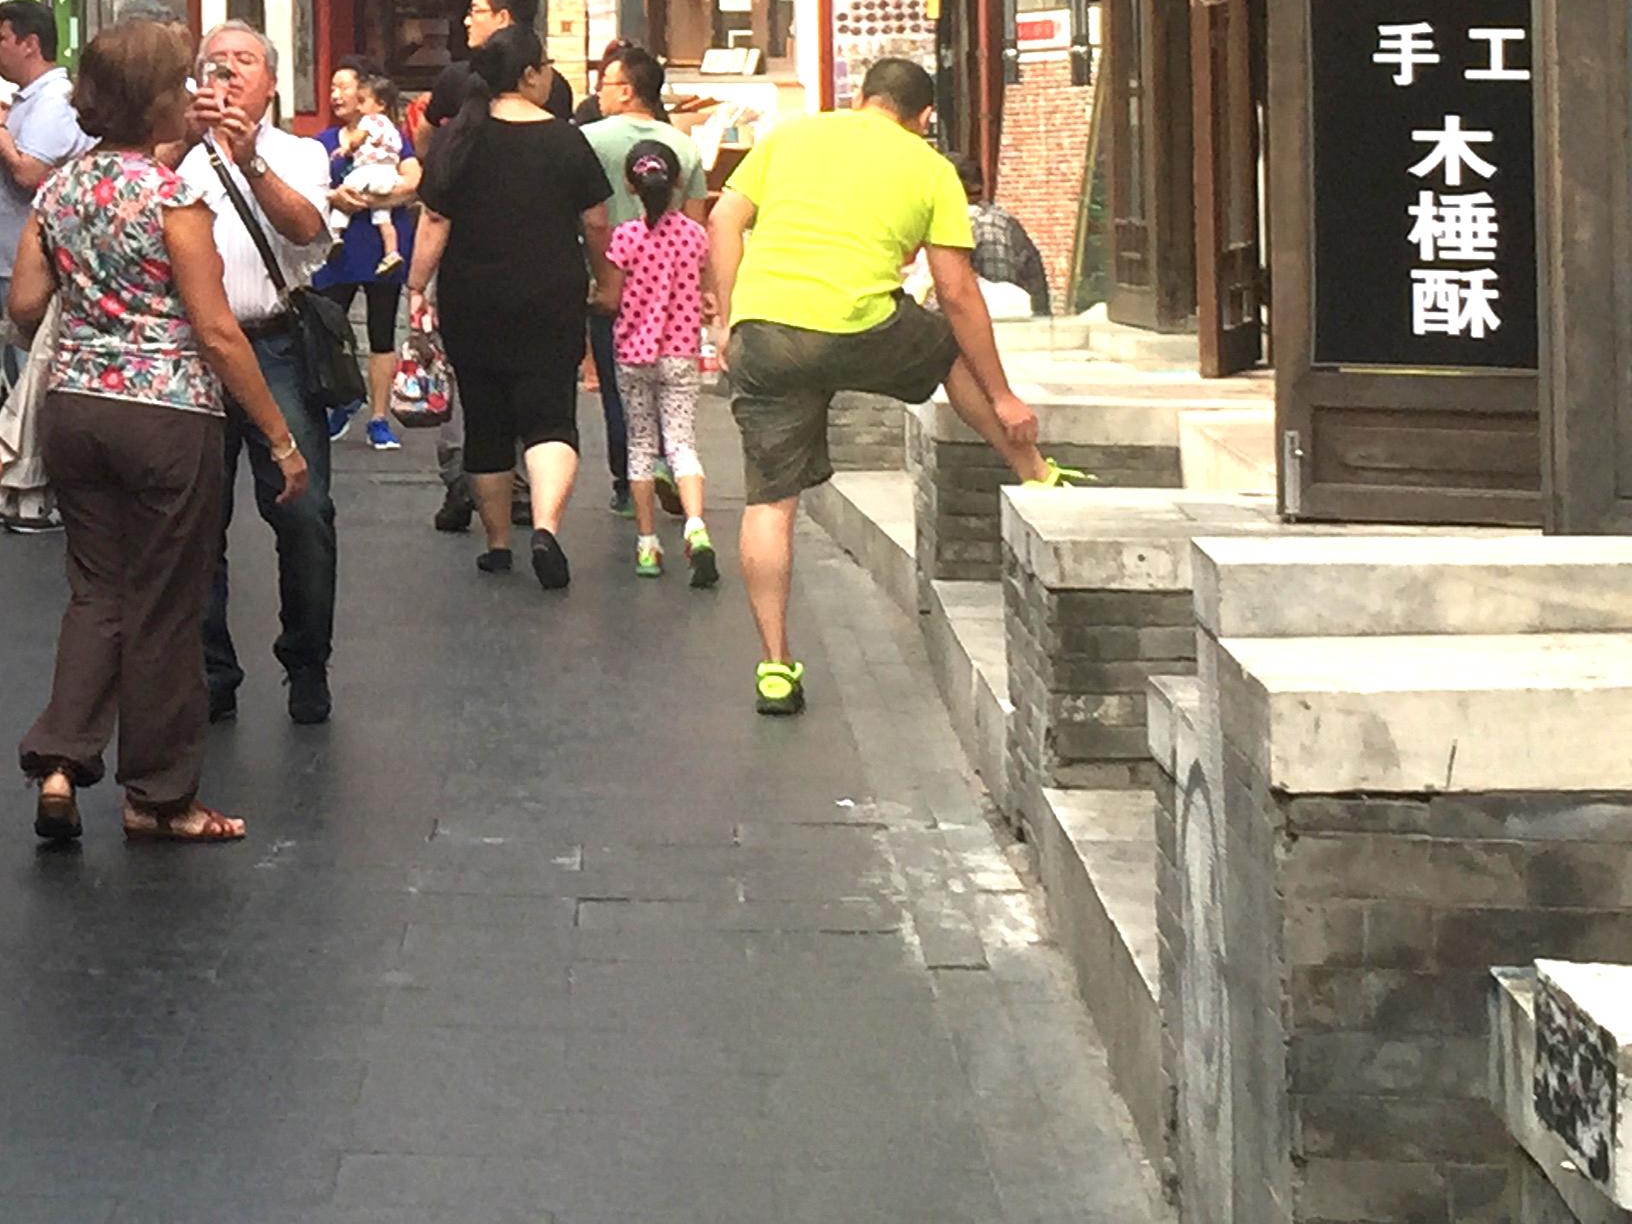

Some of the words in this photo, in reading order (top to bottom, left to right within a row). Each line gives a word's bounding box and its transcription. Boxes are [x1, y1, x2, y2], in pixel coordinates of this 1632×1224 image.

[1372, 22, 1531, 86] 手工
[1407, 115, 1501, 338] 木棰酥
